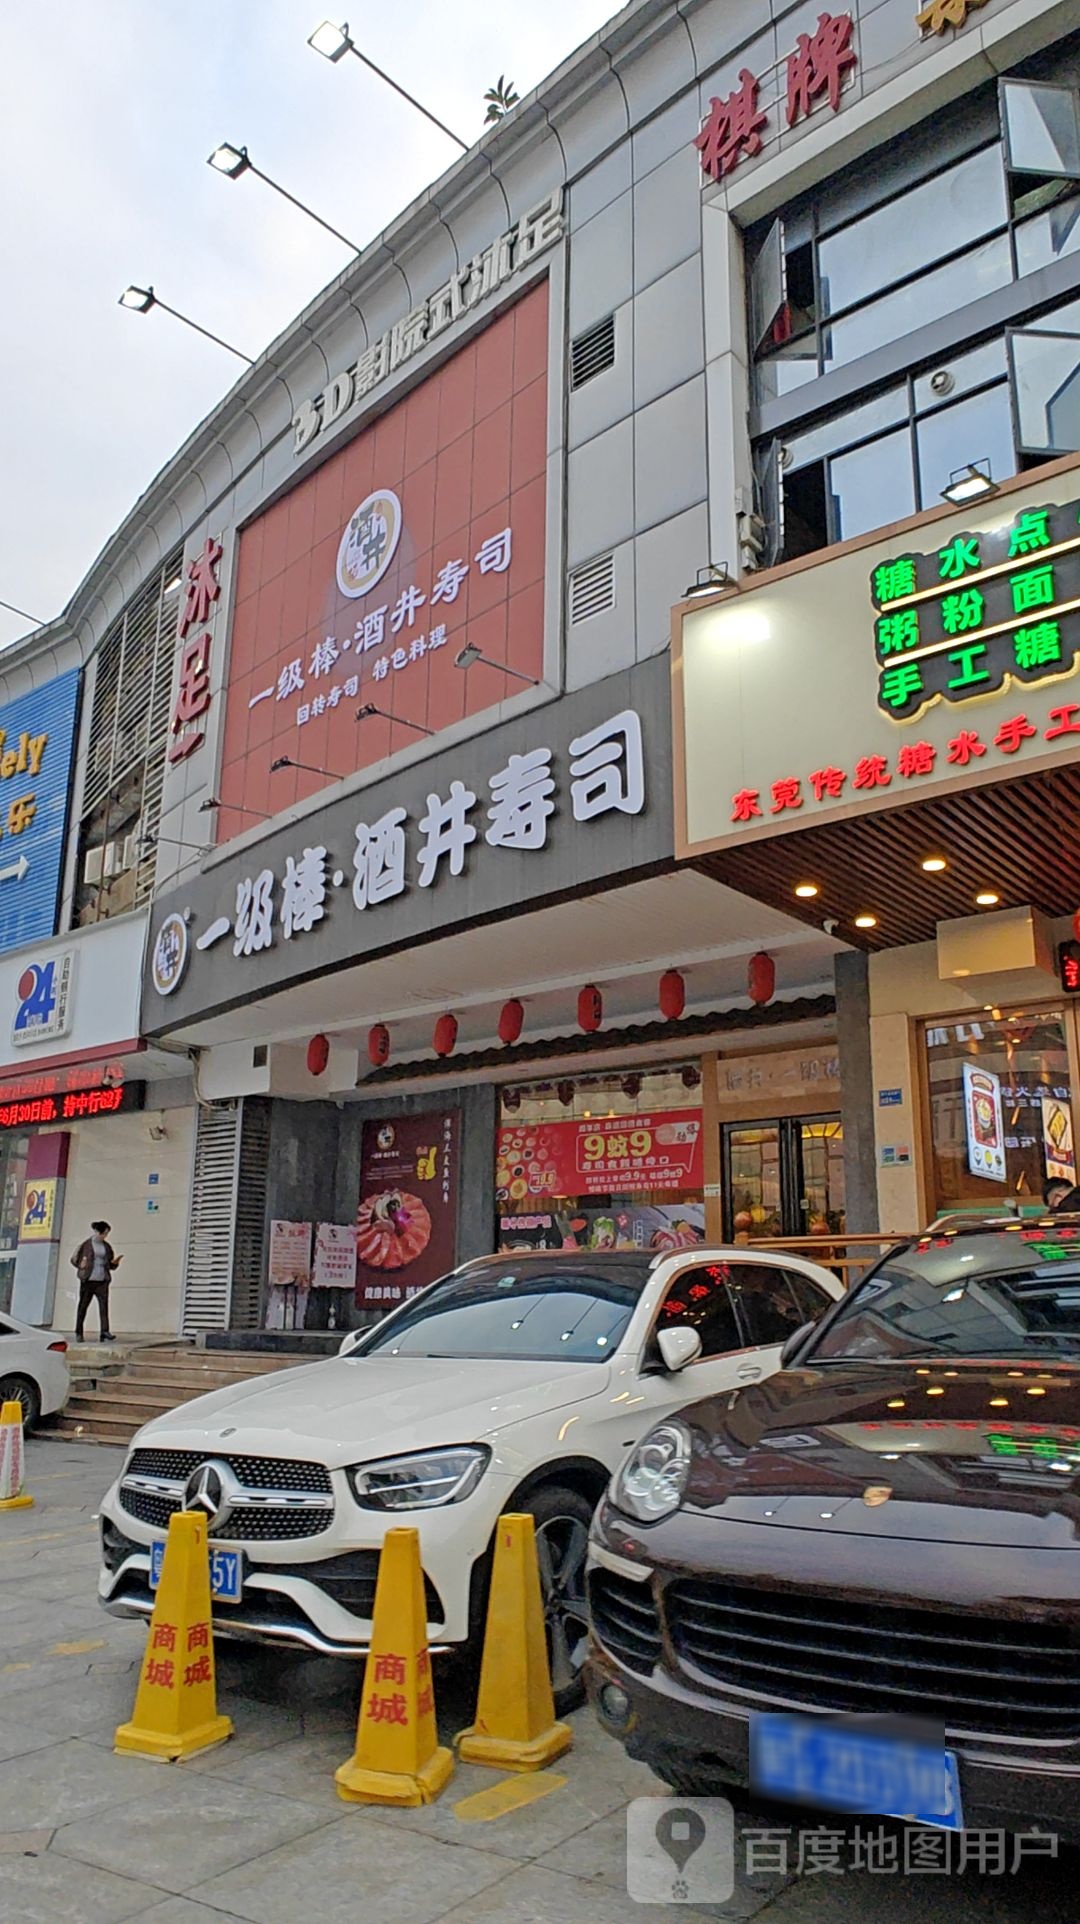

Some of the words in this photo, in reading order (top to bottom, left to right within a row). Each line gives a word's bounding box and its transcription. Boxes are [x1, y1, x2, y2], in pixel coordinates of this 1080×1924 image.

[694, 12, 857, 182] 棋牌
[248, 527, 513, 709] 一级棒·酒井寿司
[881, 620, 1063, 708] 手工糖
[296, 675, 360, 727] 回转寿司
[371, 624, 449, 681] 特色料理
[196, 708, 645, 957] 一级棒·酒井寿司
[145, 1622, 179, 1690] 商城
[184, 1621, 212, 1687] 商城
[367, 1653, 409, 1726] 商城
